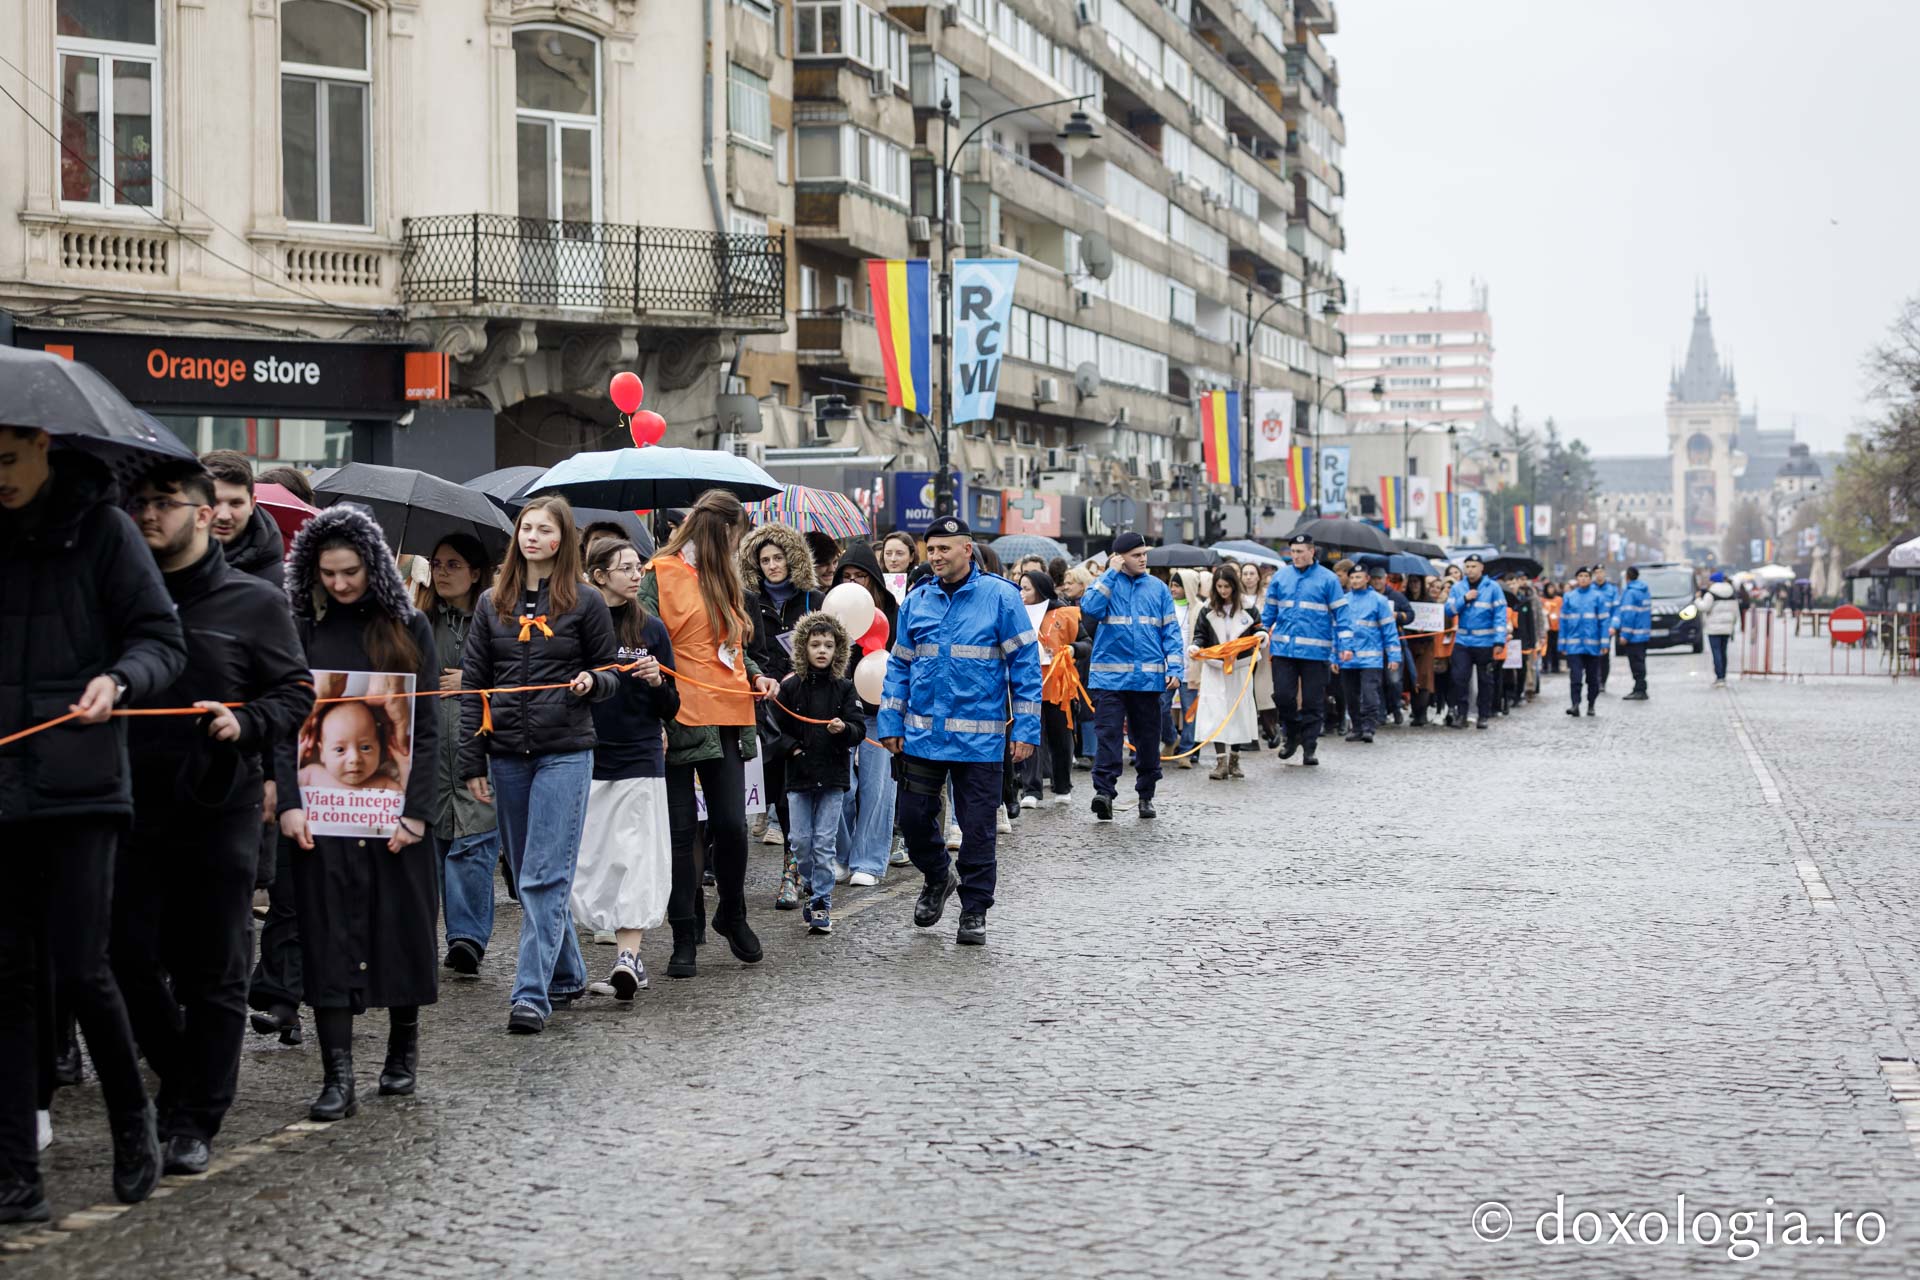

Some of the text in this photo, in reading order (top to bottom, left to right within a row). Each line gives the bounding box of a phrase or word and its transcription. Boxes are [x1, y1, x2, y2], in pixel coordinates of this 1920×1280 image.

[147, 349, 320, 387] Orange store
[406, 386, 436, 398] orange
[305, 791, 400, 811] Viața începe
[306, 807, 400, 830] la concepție
